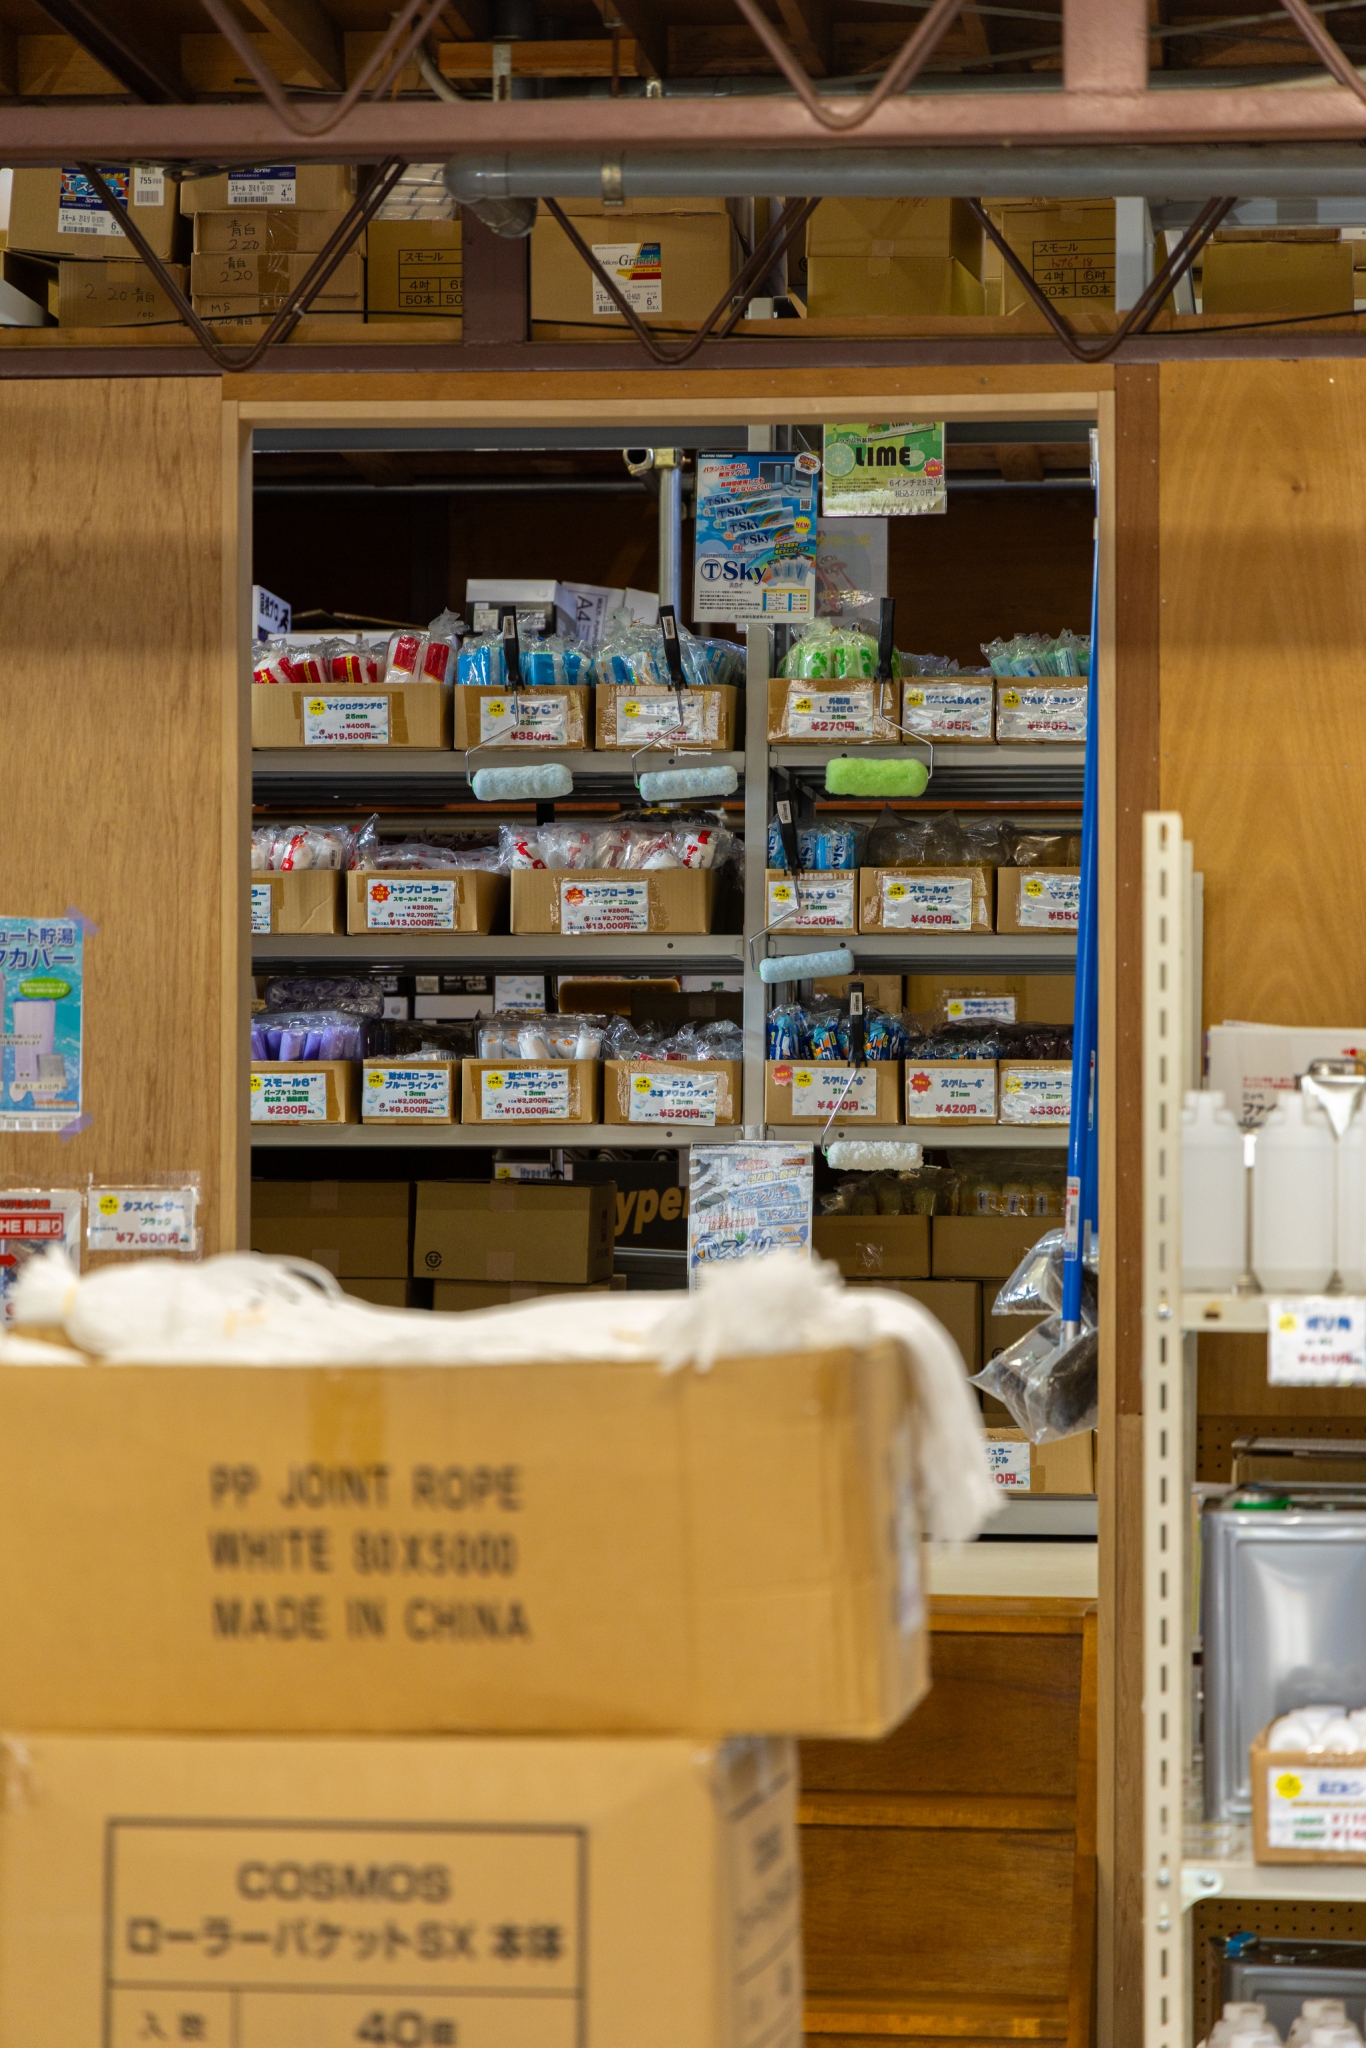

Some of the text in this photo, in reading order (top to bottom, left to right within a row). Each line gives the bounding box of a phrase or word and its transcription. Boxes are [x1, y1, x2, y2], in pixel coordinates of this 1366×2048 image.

[1039, 242, 1079, 253] スモール
[405, 252, 444, 262] スモール
[1081, 283, 1111, 295] 50本
[405, 294, 434, 305] 50本
[855, 445, 911, 467] LIME
[889, 478, 942, 488] 6インチ25ミリ
[577, 595, 593, 622] A4
[811, 721, 855, 731] ¥270円
[327, 732, 372, 741] ¥19,500円
[390, 885, 448, 894] トップローラー
[585, 888, 644, 897] トップローラー
[909, 885, 955, 894] スモール4"
[389, 919, 435, 927] ¥13,000円
[911, 914, 952, 925] ¥490円
[585, 922, 631, 930] ¥13,000円
[388, 1071, 443, 1081] 防水用ローラー
[263, 1077, 317, 1088] スモール6"
[384, 1081, 444, 1090] ブルーライン4"
[504, 1081, 565, 1090] ブルーライン6"
[950, 1090, 971, 1098] 21mm
[267, 1105, 308, 1115] ¥290円
[389, 1106, 428, 1114] ¥9,500円
[504, 1107, 549, 1115] ¥10,500円
[659, 1108, 700, 1119] ¥520円
[935, 1104, 977, 1115] ¥420円
[207, 1463, 524, 1512] PP JOINT ROPE
[208, 1527, 333, 1575] WHITE
[211, 1596, 531, 1643] MADE IN CHINA
[237, 1861, 452, 1903] COSMOS
